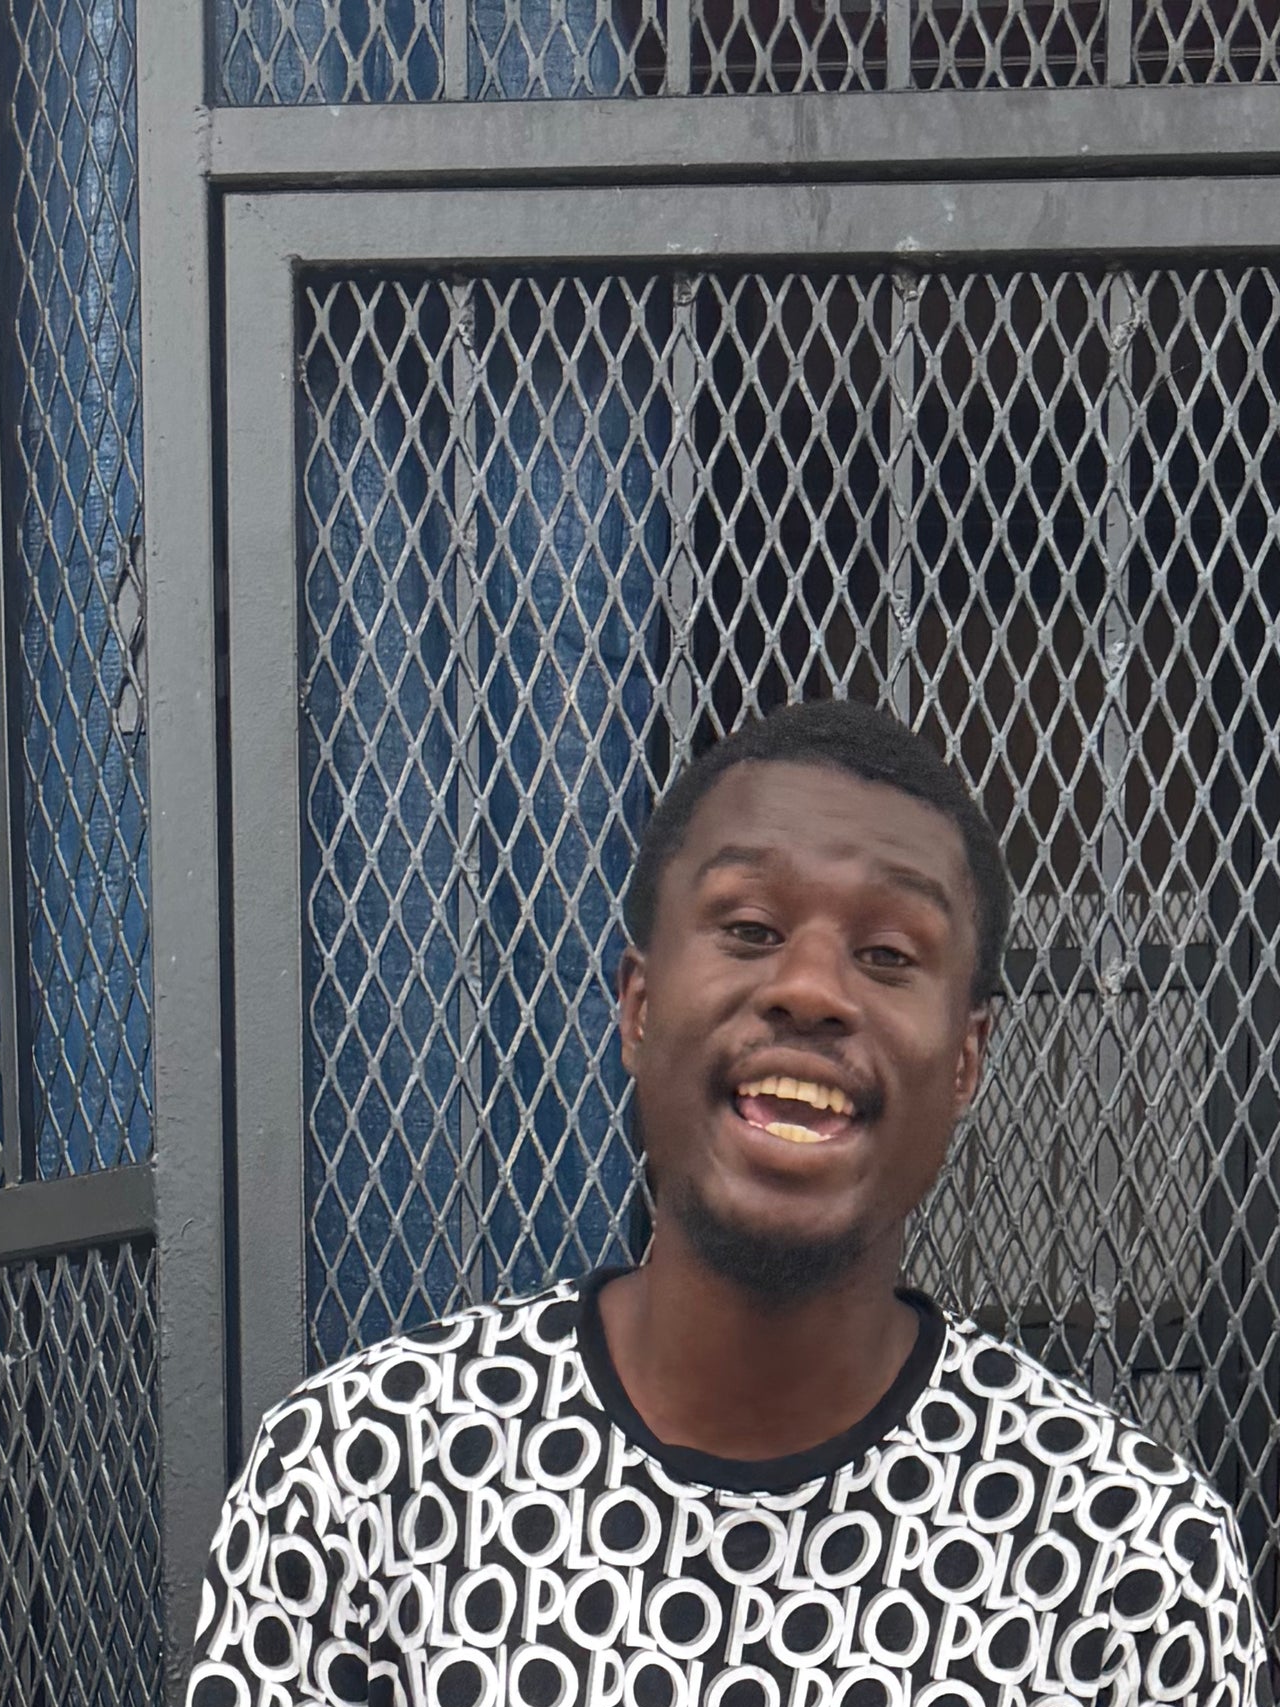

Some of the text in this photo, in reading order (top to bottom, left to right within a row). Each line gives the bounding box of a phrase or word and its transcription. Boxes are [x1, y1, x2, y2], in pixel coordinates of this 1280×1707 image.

[328, 1352, 539, 1430] POLO
[929, 1327, 1112, 1416] POL
[405, 1407, 601, 1492] POLO
[980, 1397, 1190, 1485] POLO
[829, 1443, 1034, 1533] POLO
[464, 1484, 662, 1570] POLO
[663, 1497, 882, 1591] POLO
[882, 1514, 1081, 1612] POLO
[521, 1564, 723, 1660] POLO
[724, 1585, 930, 1669] POLO
